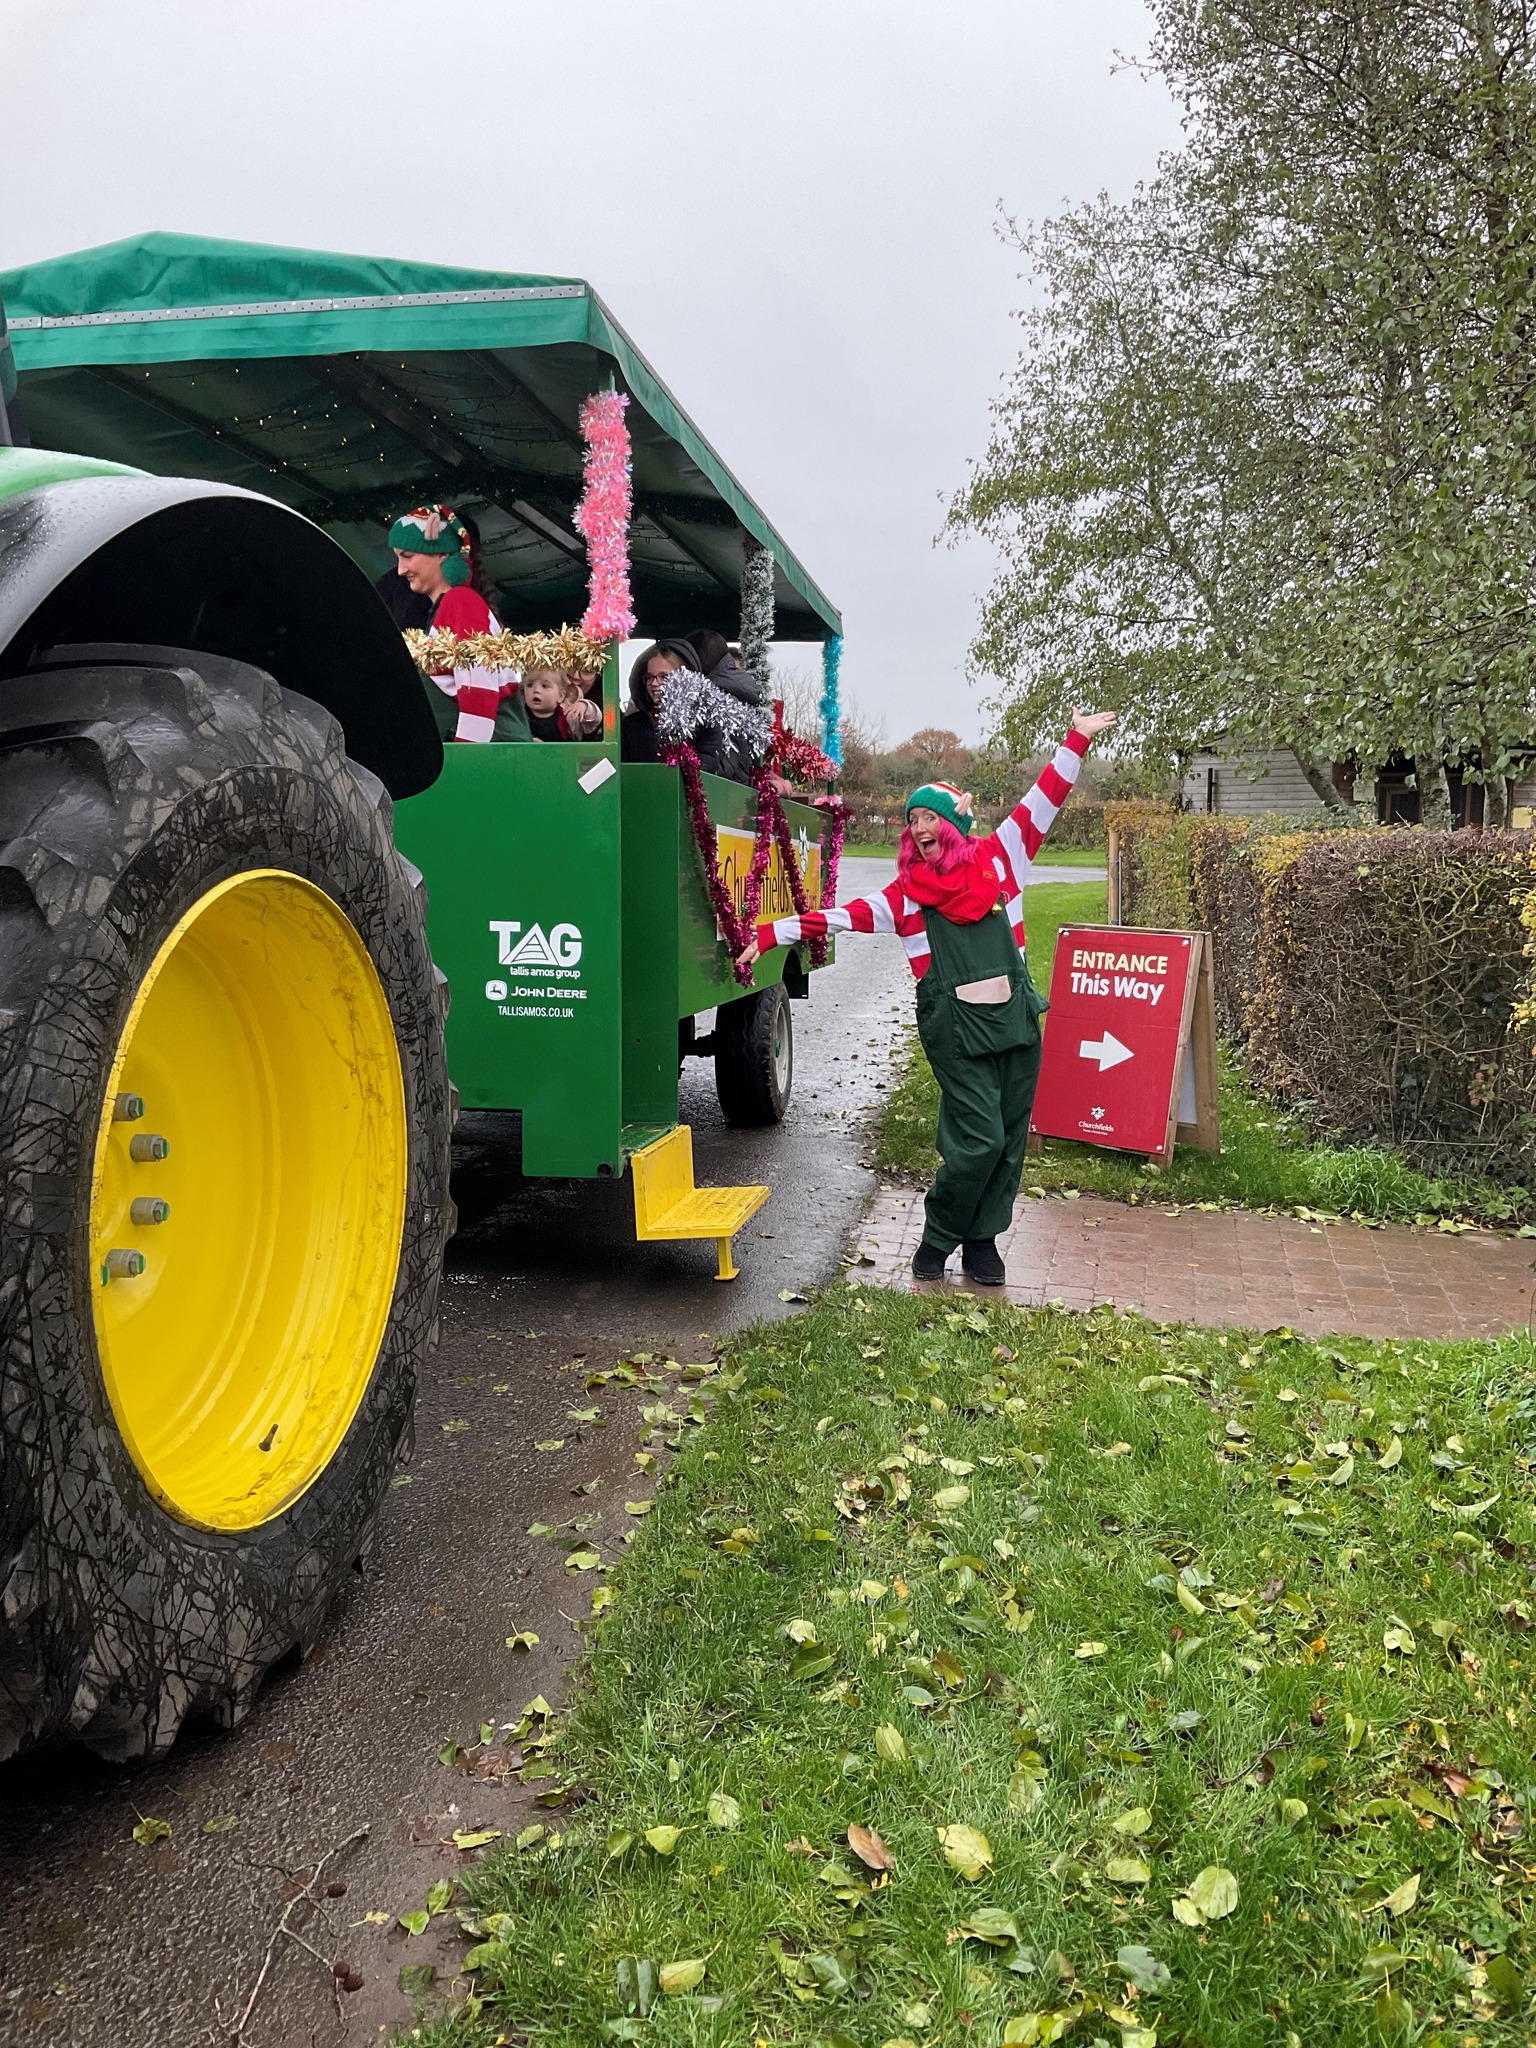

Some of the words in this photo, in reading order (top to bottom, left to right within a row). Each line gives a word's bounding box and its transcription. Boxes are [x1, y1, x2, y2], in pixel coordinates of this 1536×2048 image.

[489, 920, 582, 967] TAG
[1072, 950, 1168, 975] ENTRANCE
[510, 966, 529, 976] tallis
[555, 969, 580, 979] group
[511, 986, 545, 997] JOHN
[546, 987, 587, 998] DEERE
[1070, 972, 1110, 997] This
[1113, 976, 1165, 1005] Way
[498, 1005, 574, 1018] TALLISAMOS.CO.UK
[1078, 1120, 1114, 1132] Churchfields
